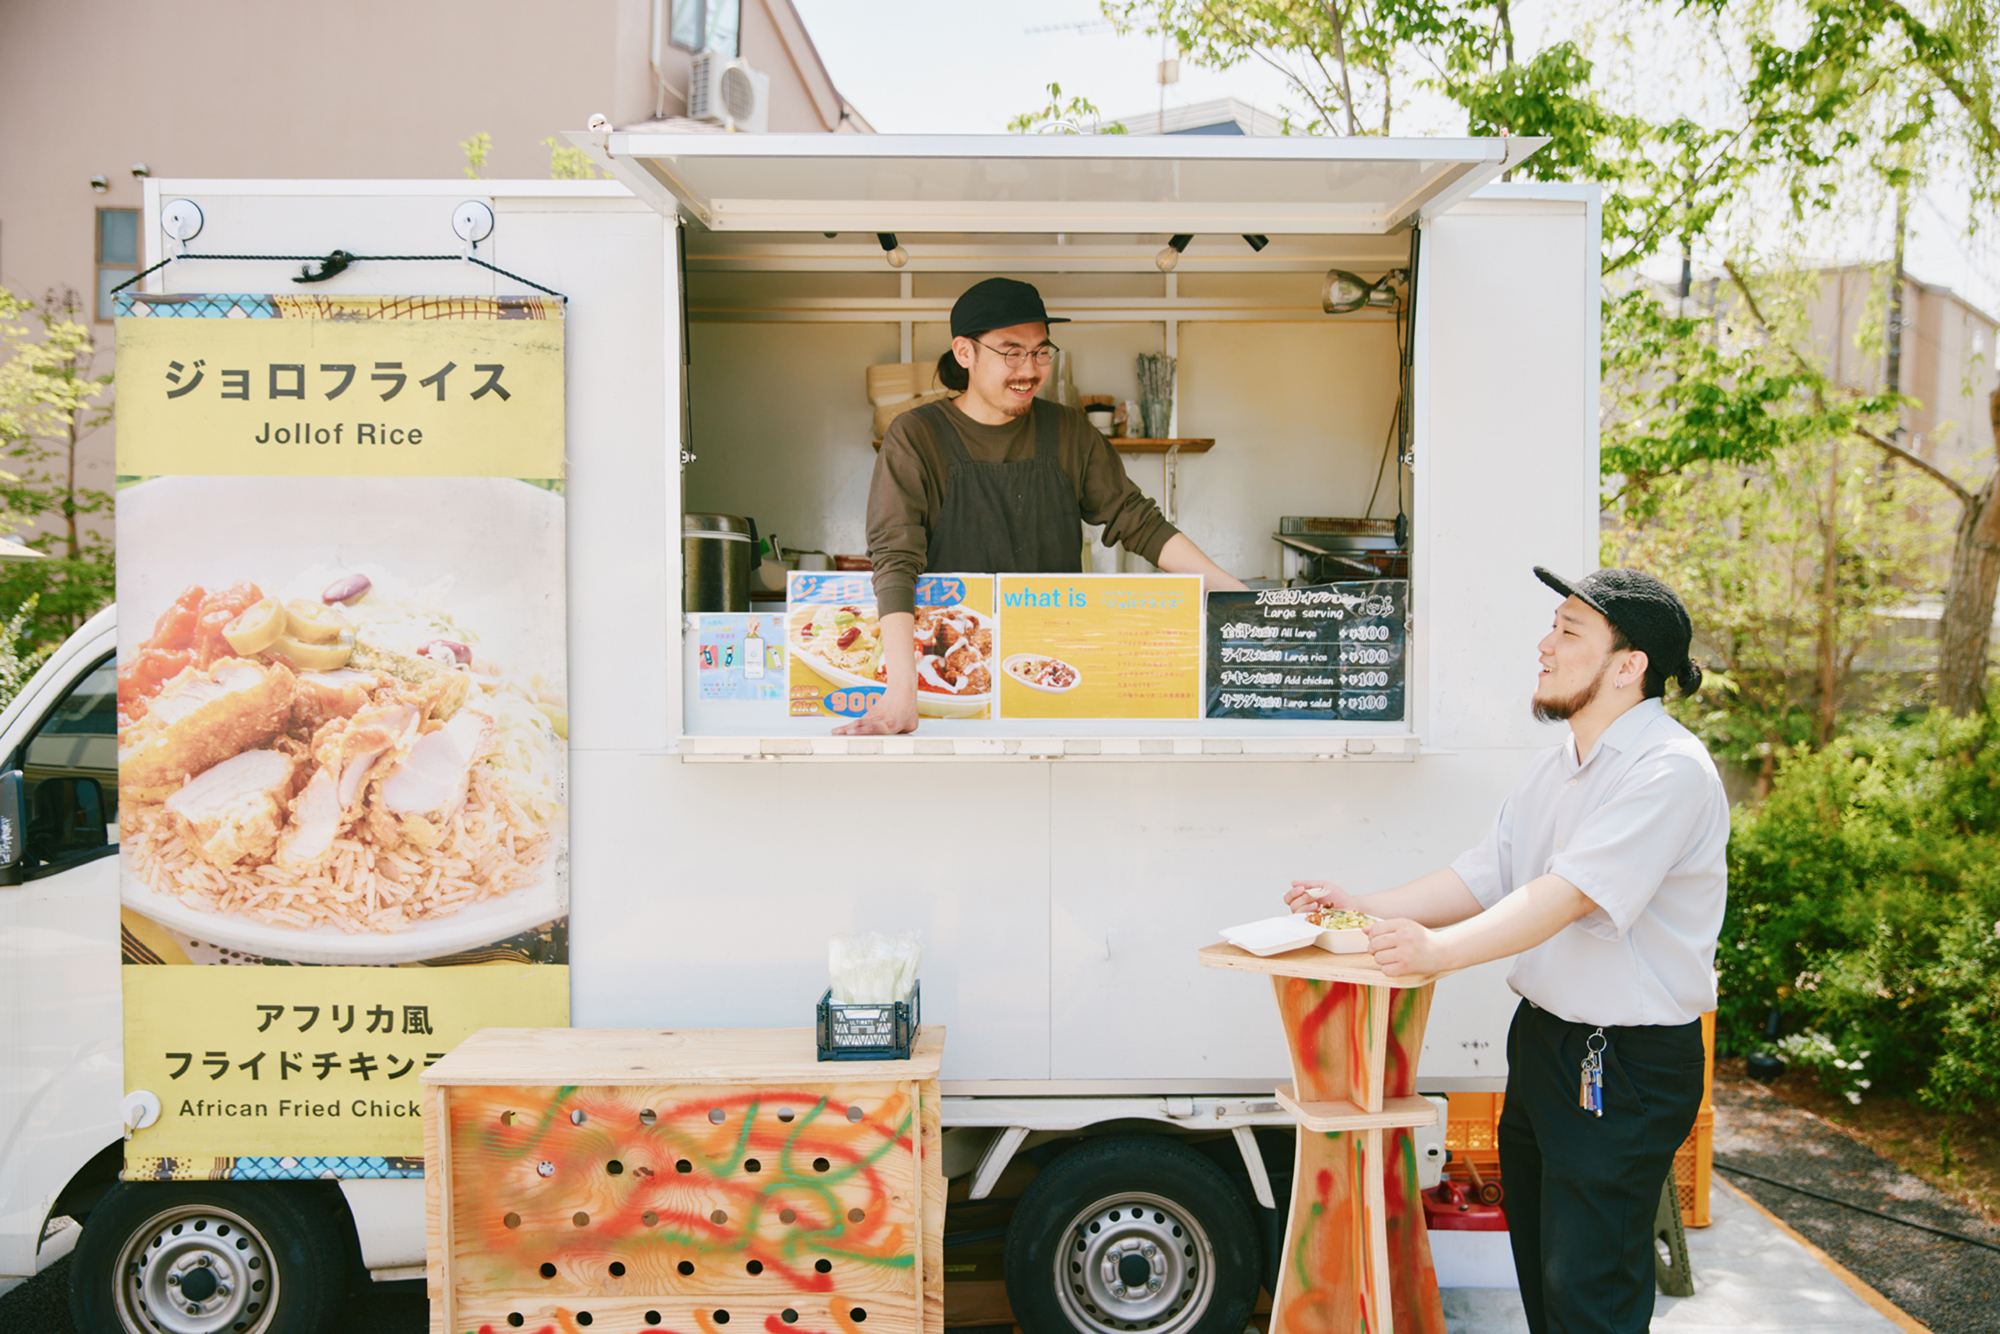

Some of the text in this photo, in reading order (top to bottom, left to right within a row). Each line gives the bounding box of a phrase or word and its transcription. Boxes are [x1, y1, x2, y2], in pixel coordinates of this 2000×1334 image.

[164, 358, 512, 402] ジョロフライス
[255, 422, 424, 446] Jollof Rice
[794, 577, 962, 602] ジョロイス
[1003, 586, 1087, 608] what is
[1264, 606, 1344, 619] Large serving
[1220, 623, 1279, 639] 全部大盛り
[1281, 627, 1317, 639] All large
[1221, 647, 1283, 662] ライス大盛り
[1285, 651, 1328, 663] Large rice
[1220, 670, 1283, 686] チキン大盛り
[1284, 675, 1334, 686] Add chicken
[1219, 693, 1283, 709] サラダ大盛り
[1284, 697, 1333, 709] Large salad
[256, 1004, 434, 1035] アフリカ風
[179, 1099, 268, 1118] African
[279, 1099, 341, 1118] Fried
